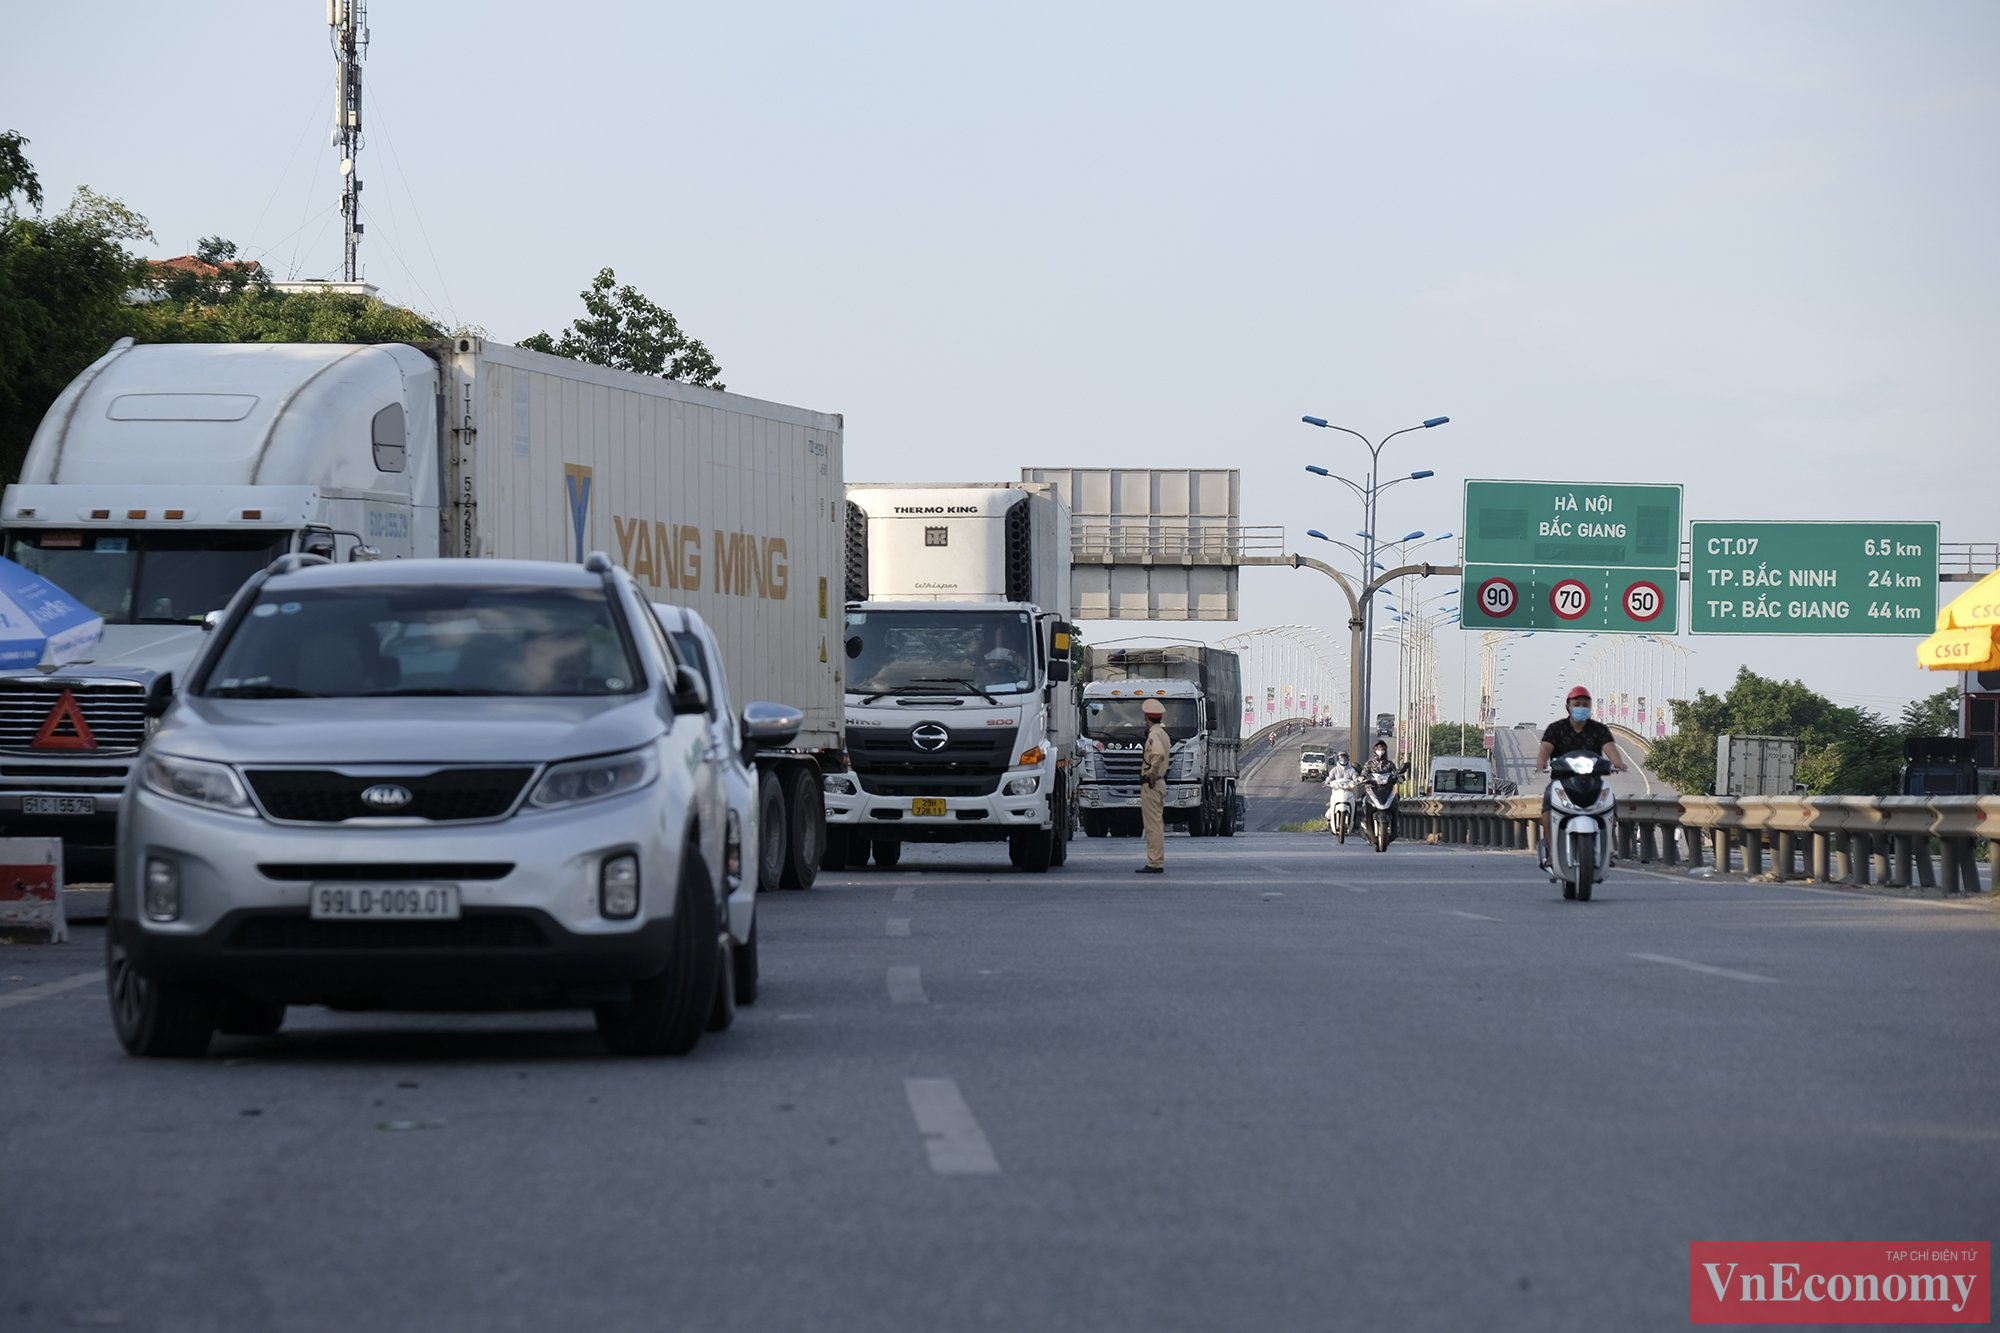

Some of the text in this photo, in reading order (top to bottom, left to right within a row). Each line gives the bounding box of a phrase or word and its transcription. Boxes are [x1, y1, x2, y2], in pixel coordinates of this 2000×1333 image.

[894, 506, 944, 514] THERMO
[1554, 493, 1613, 516] HÀ NỘI
[1539, 515, 1627, 539] BẮC GIANG
[1707, 538, 1922, 557] CT.07 6.5 km
[613, 515, 701, 591] YANG
[714, 529, 788, 601] MING
[1742, 561, 1783, 587] BẮC
[1788, 569, 1837, 587] NINH
[1868, 570, 1893, 588] 24
[1895, 573, 1922, 588] km
[1486, 587, 1510, 607] 90
[1559, 590, 1582, 609] 70
[1631, 592, 1654, 611] 50
[1707, 593, 1921, 619] TP. BẮC GIANG 44 km
[1935, 643, 1970, 658] CSGT
[369, 788, 405, 804] KIA
[319, 889, 449, 915] 99LD-009.01
